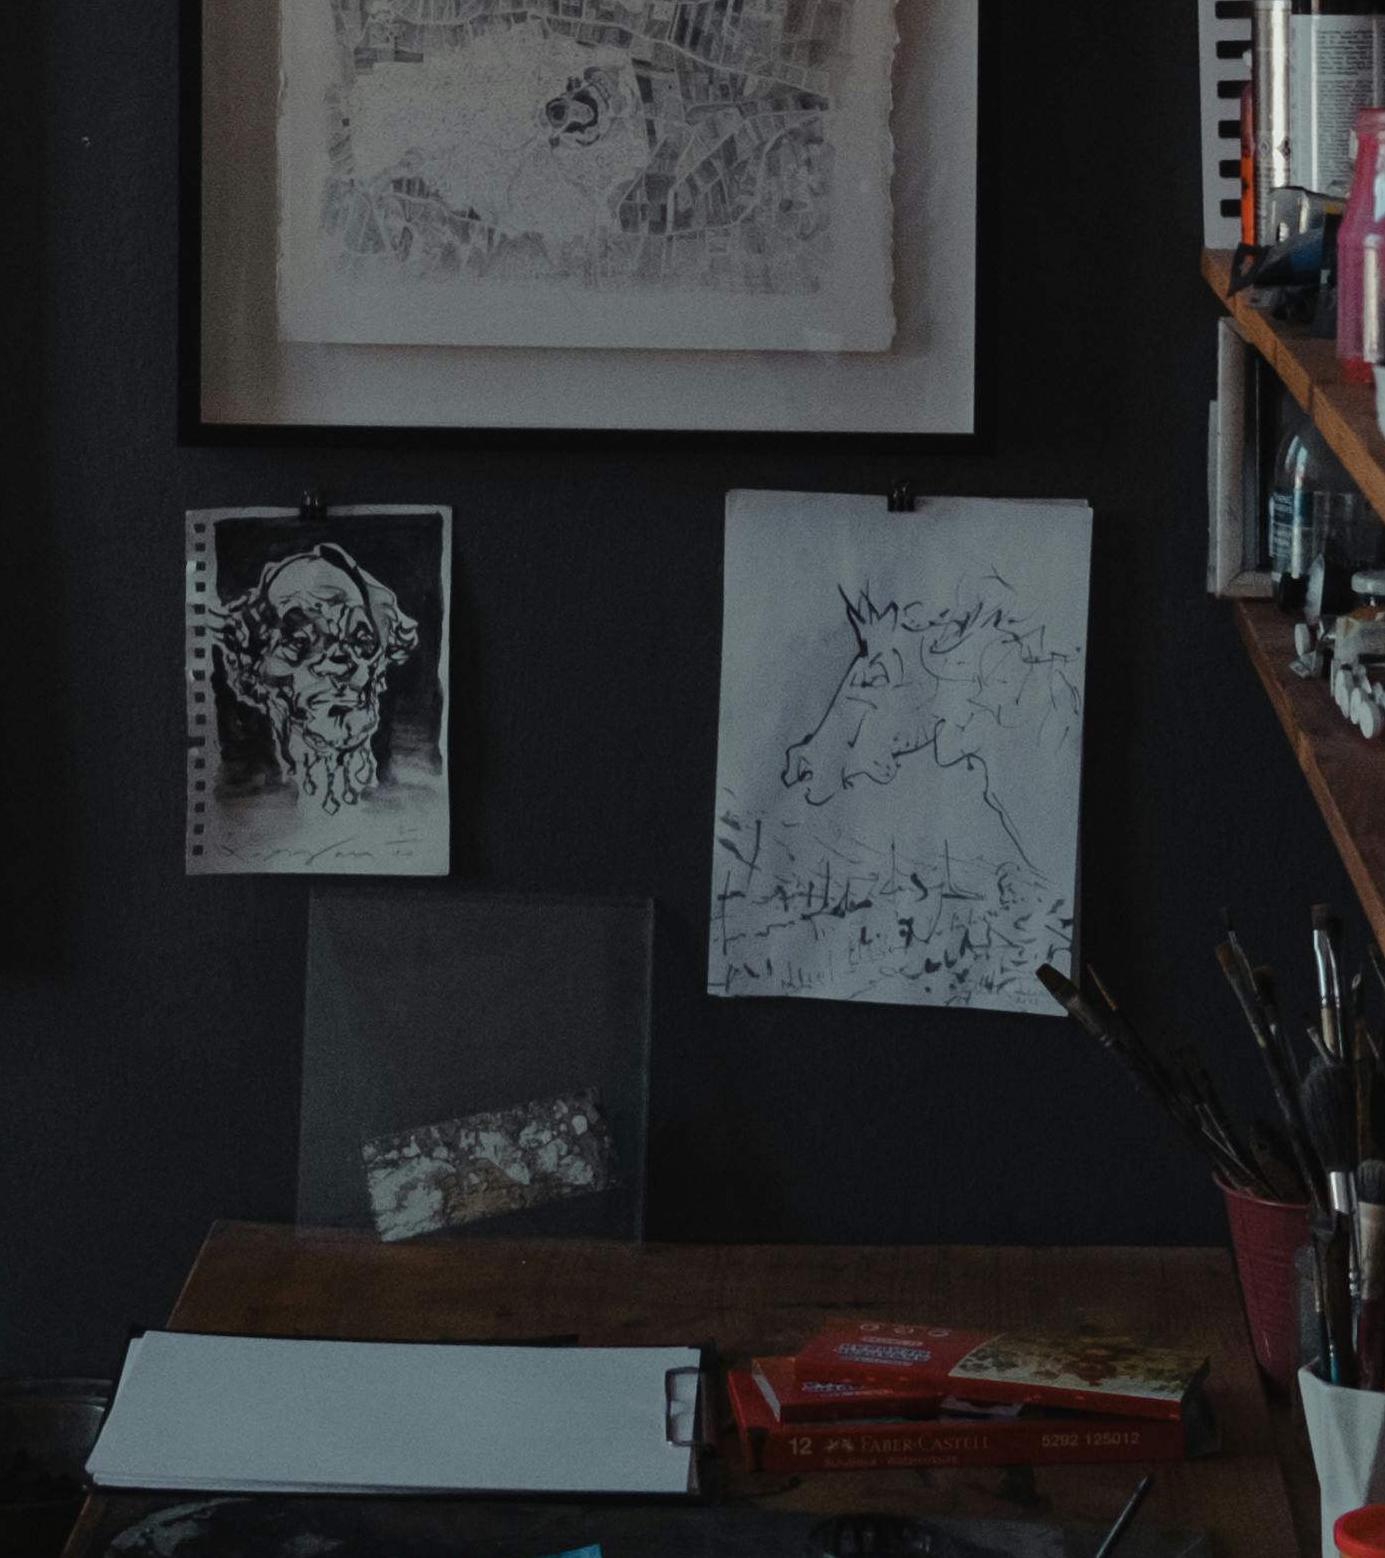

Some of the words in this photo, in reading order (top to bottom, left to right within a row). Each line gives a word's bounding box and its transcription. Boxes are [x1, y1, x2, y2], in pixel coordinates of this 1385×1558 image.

[789, 1436, 812, 1455] 12
[861, 1433, 991, 1453] FABER-CASTELL
[1085, 1431, 1141, 1447] 125012
